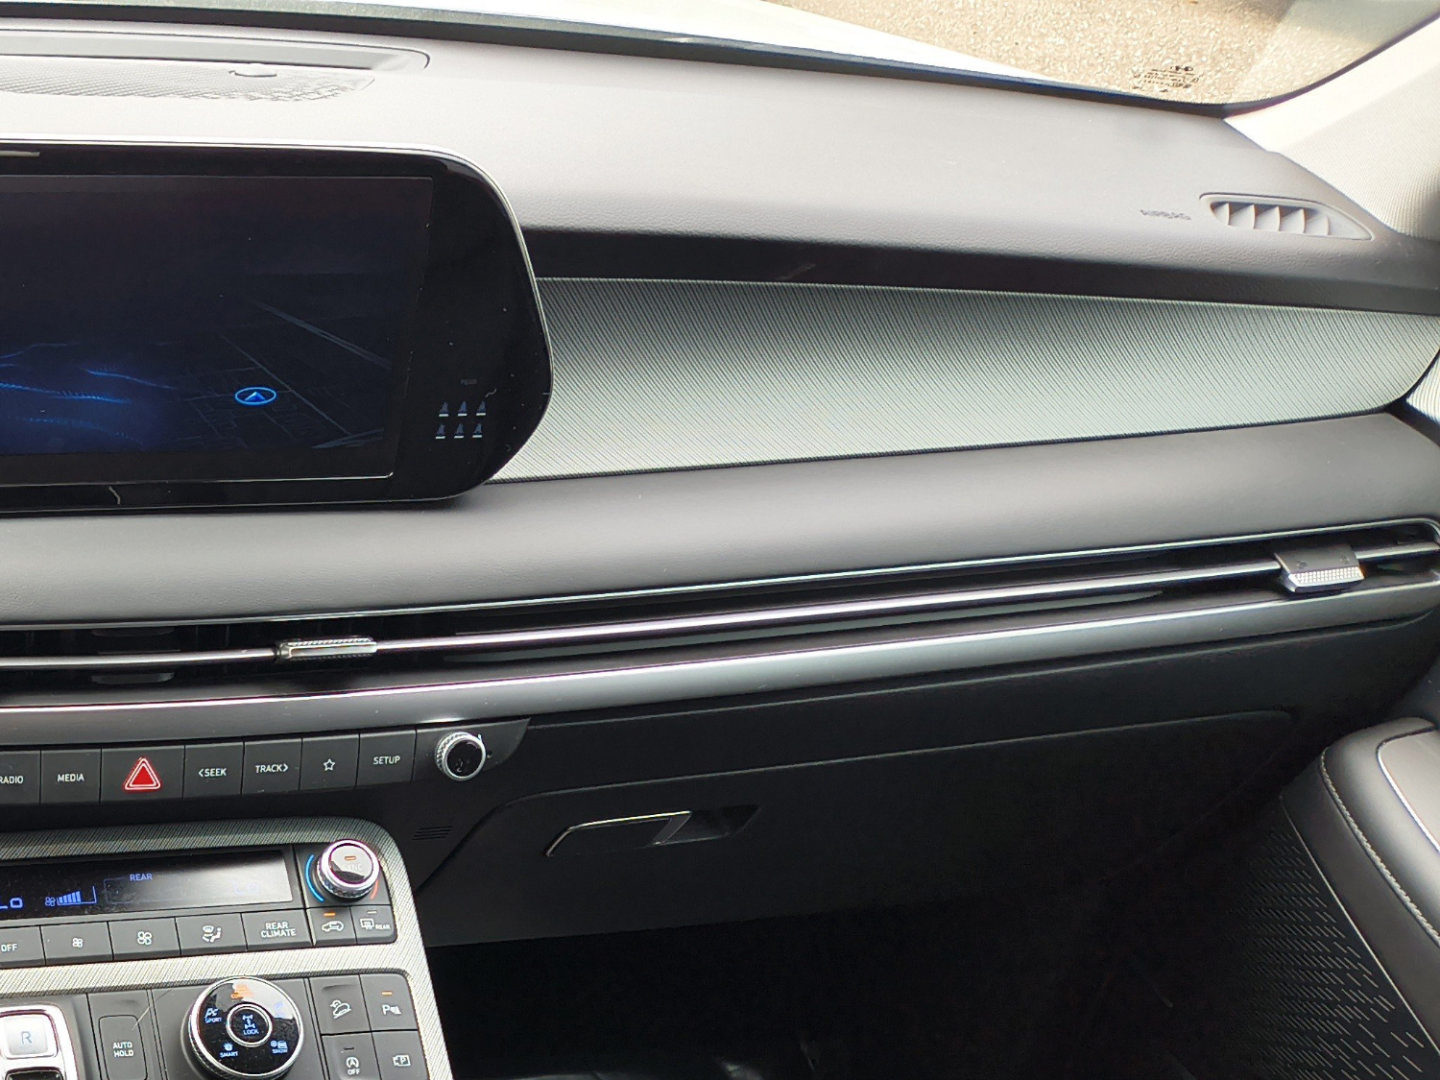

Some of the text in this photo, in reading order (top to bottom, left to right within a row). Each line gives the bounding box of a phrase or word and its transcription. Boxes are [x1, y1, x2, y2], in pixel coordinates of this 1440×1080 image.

[372, 754, 401, 766] SETUP
[56, 773, 85, 783] MEDIA
[129, 873, 153, 882] REAR
[266, 922, 289, 930] REAR
[260, 929, 297, 938] CLIMATE
[1, 943, 18, 953] OFF
[243, 1027, 260, 1036] LOCK
[21, 1031, 33, 1044] R
[113, 1041, 134, 1050] AUTO
[114, 1049, 135, 1058] HOLD
[219, 1049, 240, 1059] SMART
[347, 1067, 361, 1076] OFF
